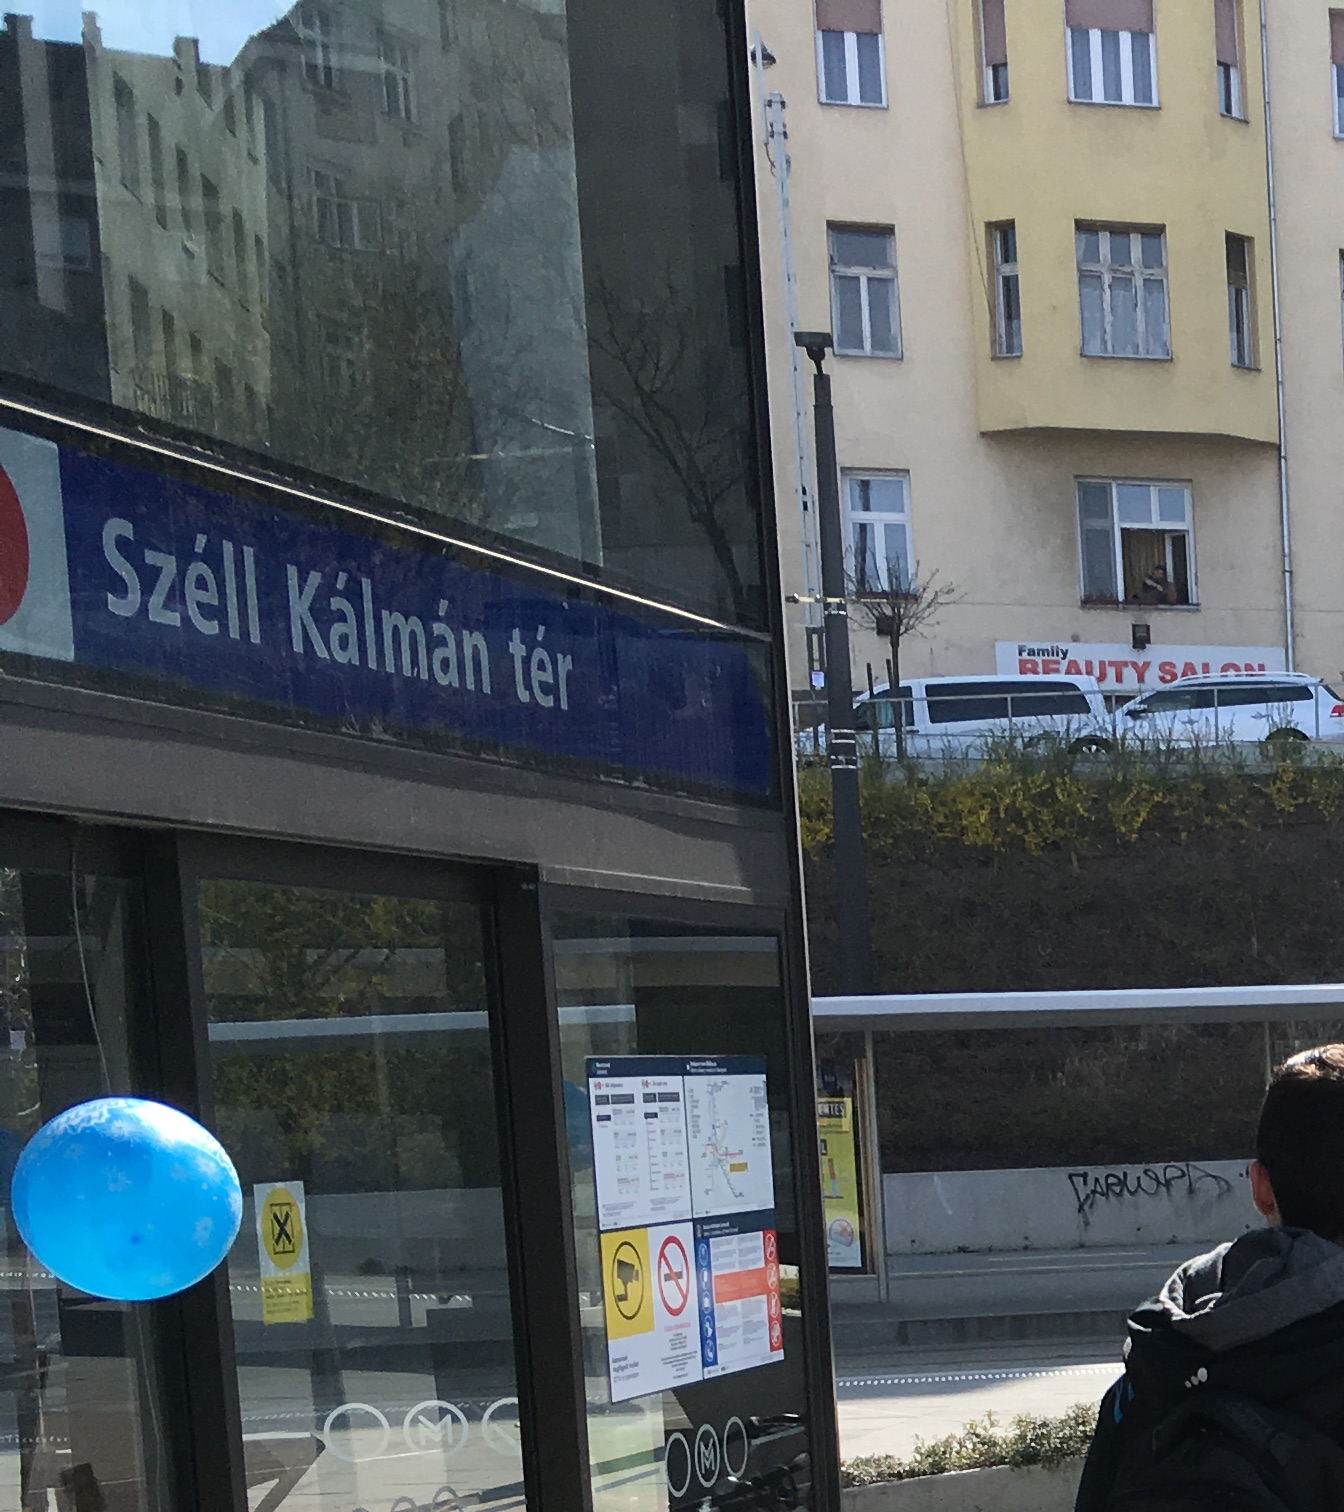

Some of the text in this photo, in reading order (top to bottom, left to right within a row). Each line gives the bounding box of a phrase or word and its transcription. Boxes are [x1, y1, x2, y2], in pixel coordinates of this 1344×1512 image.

[103, 517, 573, 711] Széll Kálmán tér
[1017, 644, 1069, 660] Family
[1018, 659, 1152, 684] BEAUTY
